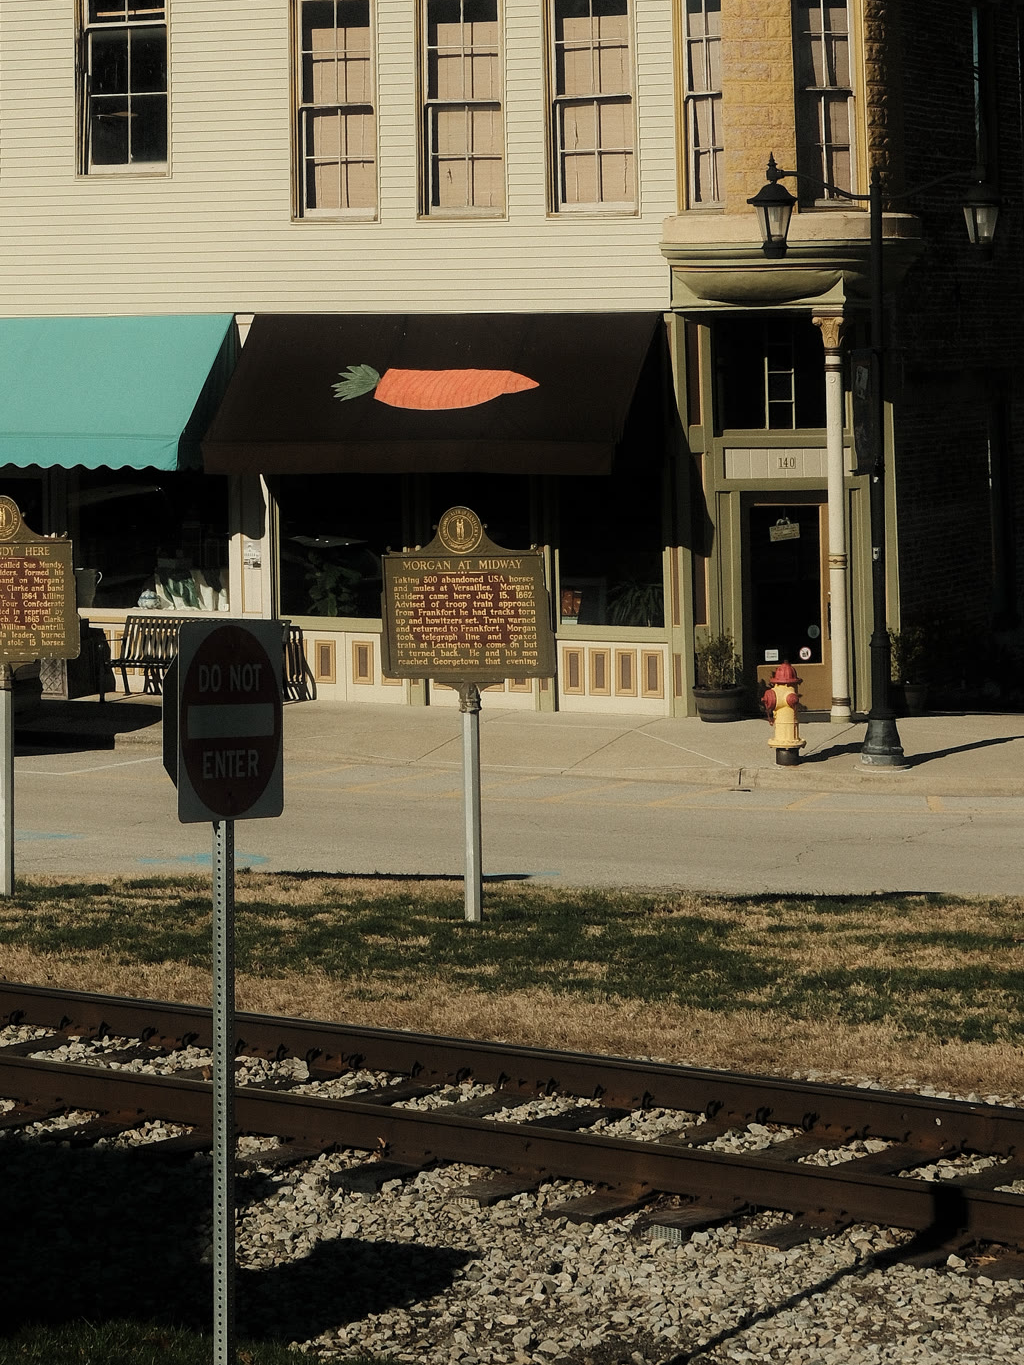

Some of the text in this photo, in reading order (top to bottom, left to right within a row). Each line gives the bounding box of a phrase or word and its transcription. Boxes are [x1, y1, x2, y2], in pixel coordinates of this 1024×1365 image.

[778, 458, 795, 468] 140
[26, 547, 50, 556] HERE
[403, 560, 522, 570] MORGAN AT MIDWAY
[34, 577, 64, 585] Morgan's
[394, 576, 419, 585] Taking
[500, 584, 534, 592] Morgan's
[476, 592, 494, 601] July
[499, 600, 535, 608] approach
[24, 608, 51, 616] reprisal
[396, 618, 405, 626] up
[507, 624, 536, 633] Morgan
[422, 634, 458, 642] telegraph
[432, 642, 470, 650] Lexington
[433, 658, 479, 666] Georgetown
[506, 658, 539, 666] evening.
[199, 663, 262, 692] DO NOT
[202, 750, 260, 780] ENTER
